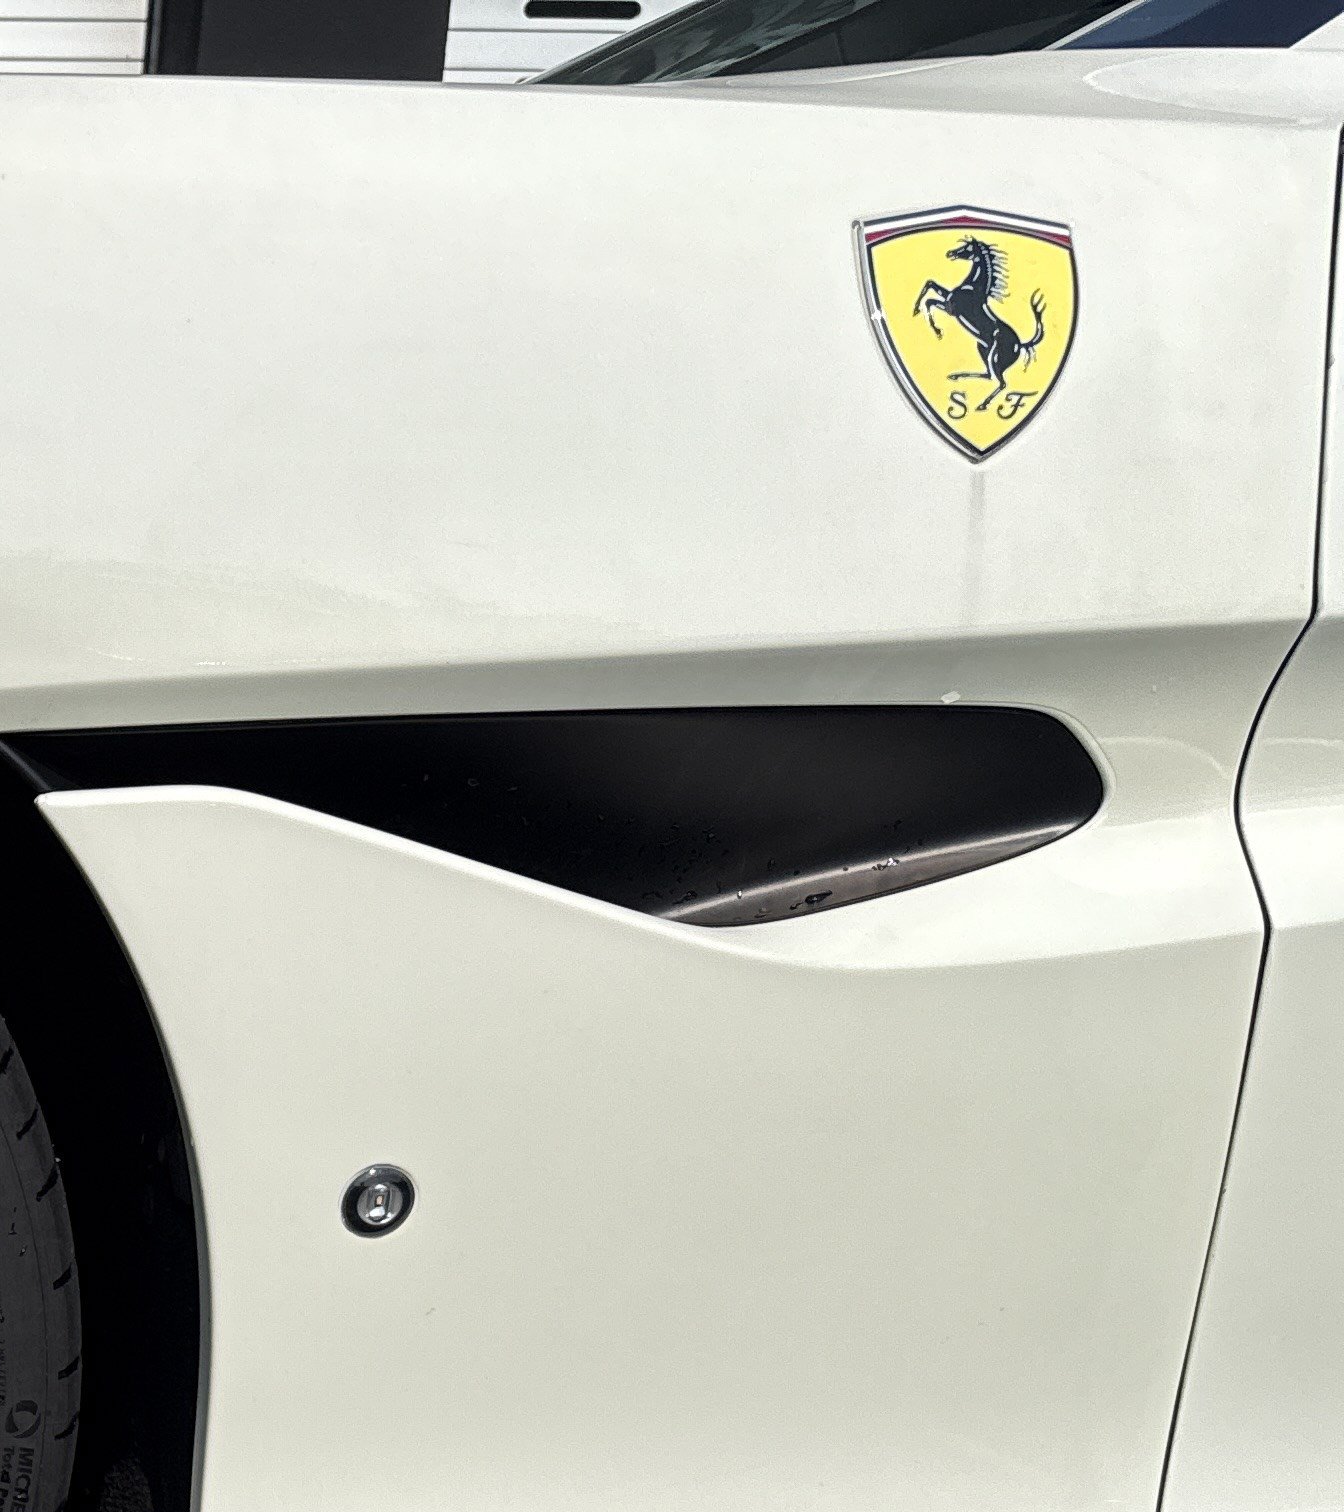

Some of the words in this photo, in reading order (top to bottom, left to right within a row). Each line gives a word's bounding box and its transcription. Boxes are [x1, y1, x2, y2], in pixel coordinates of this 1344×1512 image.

[947, 391, 968, 420] S
[998, 391, 1038, 420] F
[0, 1444, 15, 1484] Total
